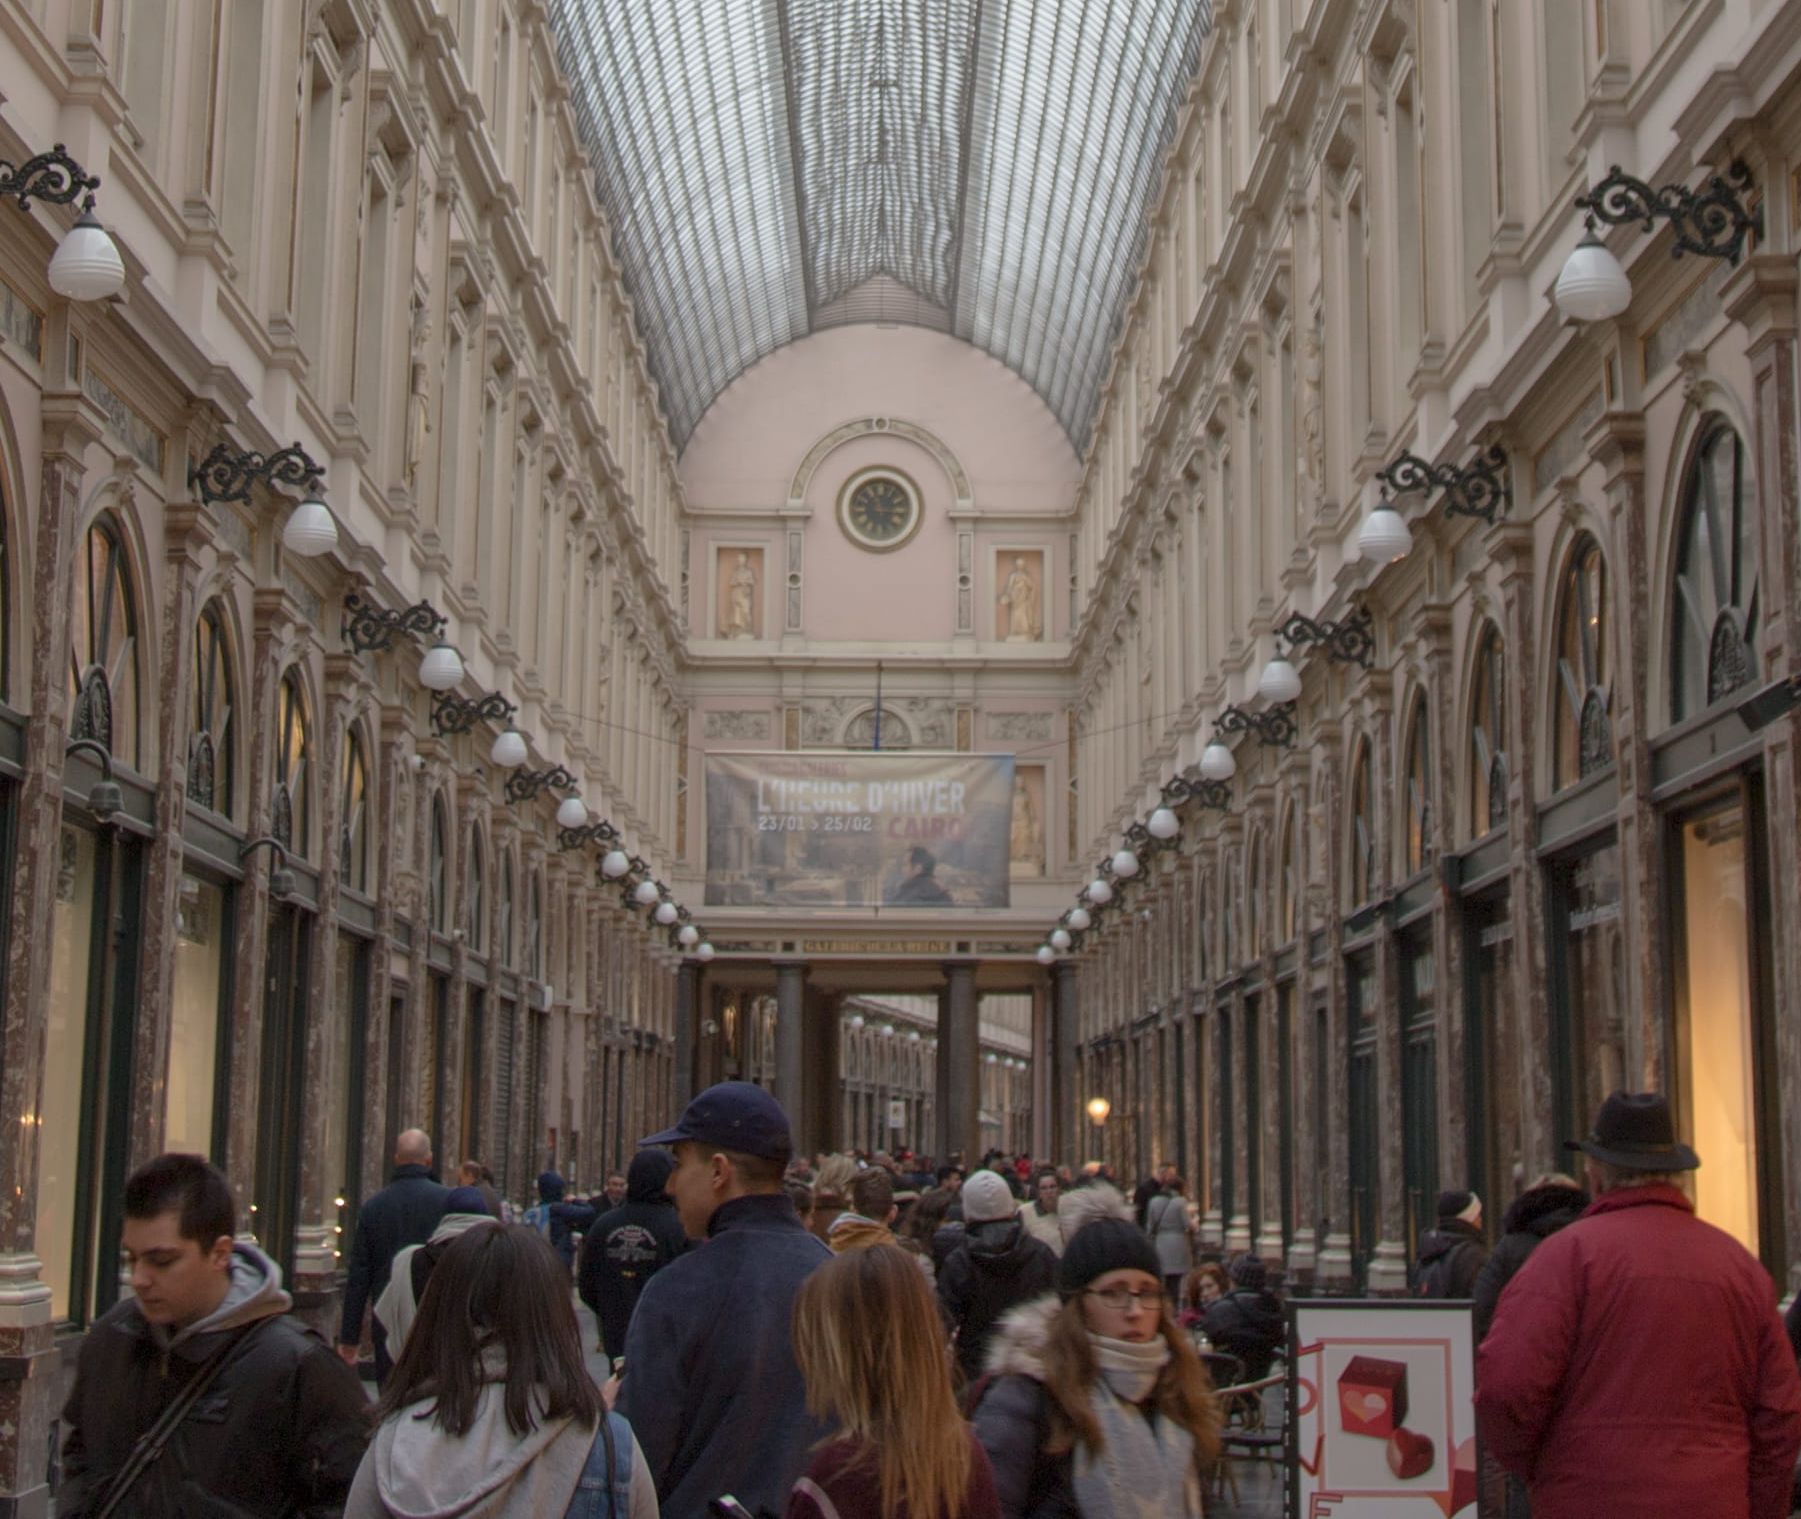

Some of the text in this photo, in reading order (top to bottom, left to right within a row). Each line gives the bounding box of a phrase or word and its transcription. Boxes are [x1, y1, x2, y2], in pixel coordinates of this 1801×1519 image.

[867, 779, 966, 814] D'HIVER
[758, 815, 805, 832] 23/01
[823, 815, 873, 832] 25/02
[887, 817, 964, 840] CAIRO
